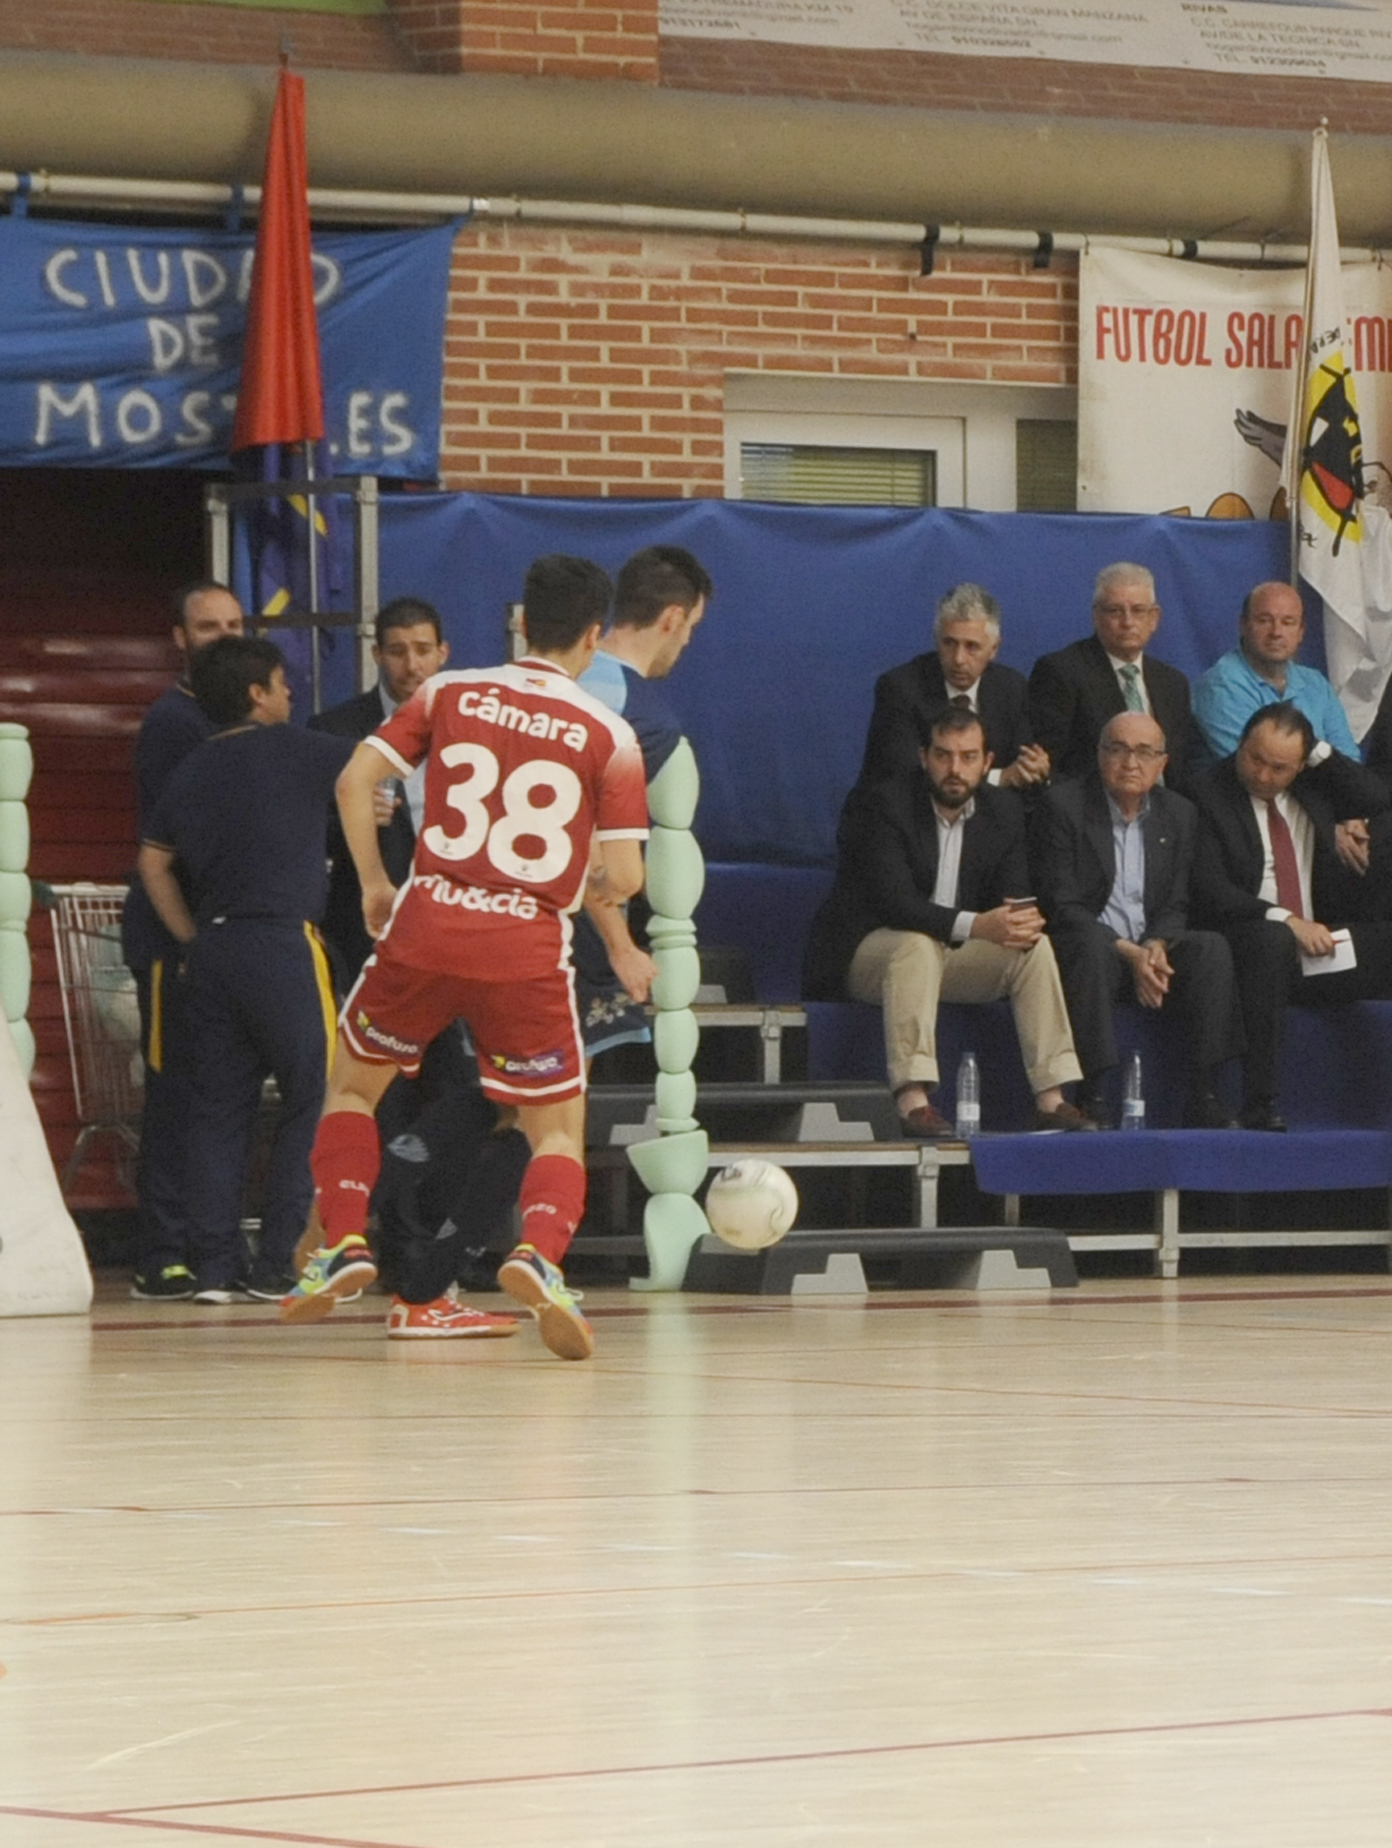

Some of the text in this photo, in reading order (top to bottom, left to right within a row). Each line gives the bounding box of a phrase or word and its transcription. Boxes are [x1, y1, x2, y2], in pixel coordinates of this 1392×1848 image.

[45, 248, 341, 308] CIUDD
[147, 313, 220, 372] DE
[1096, 305, 1213, 367] FUTBOL
[1225, 311, 1304, 370] SALA
[35, 382, 415, 457] MOSES
[423, 742, 582, 883] 38
